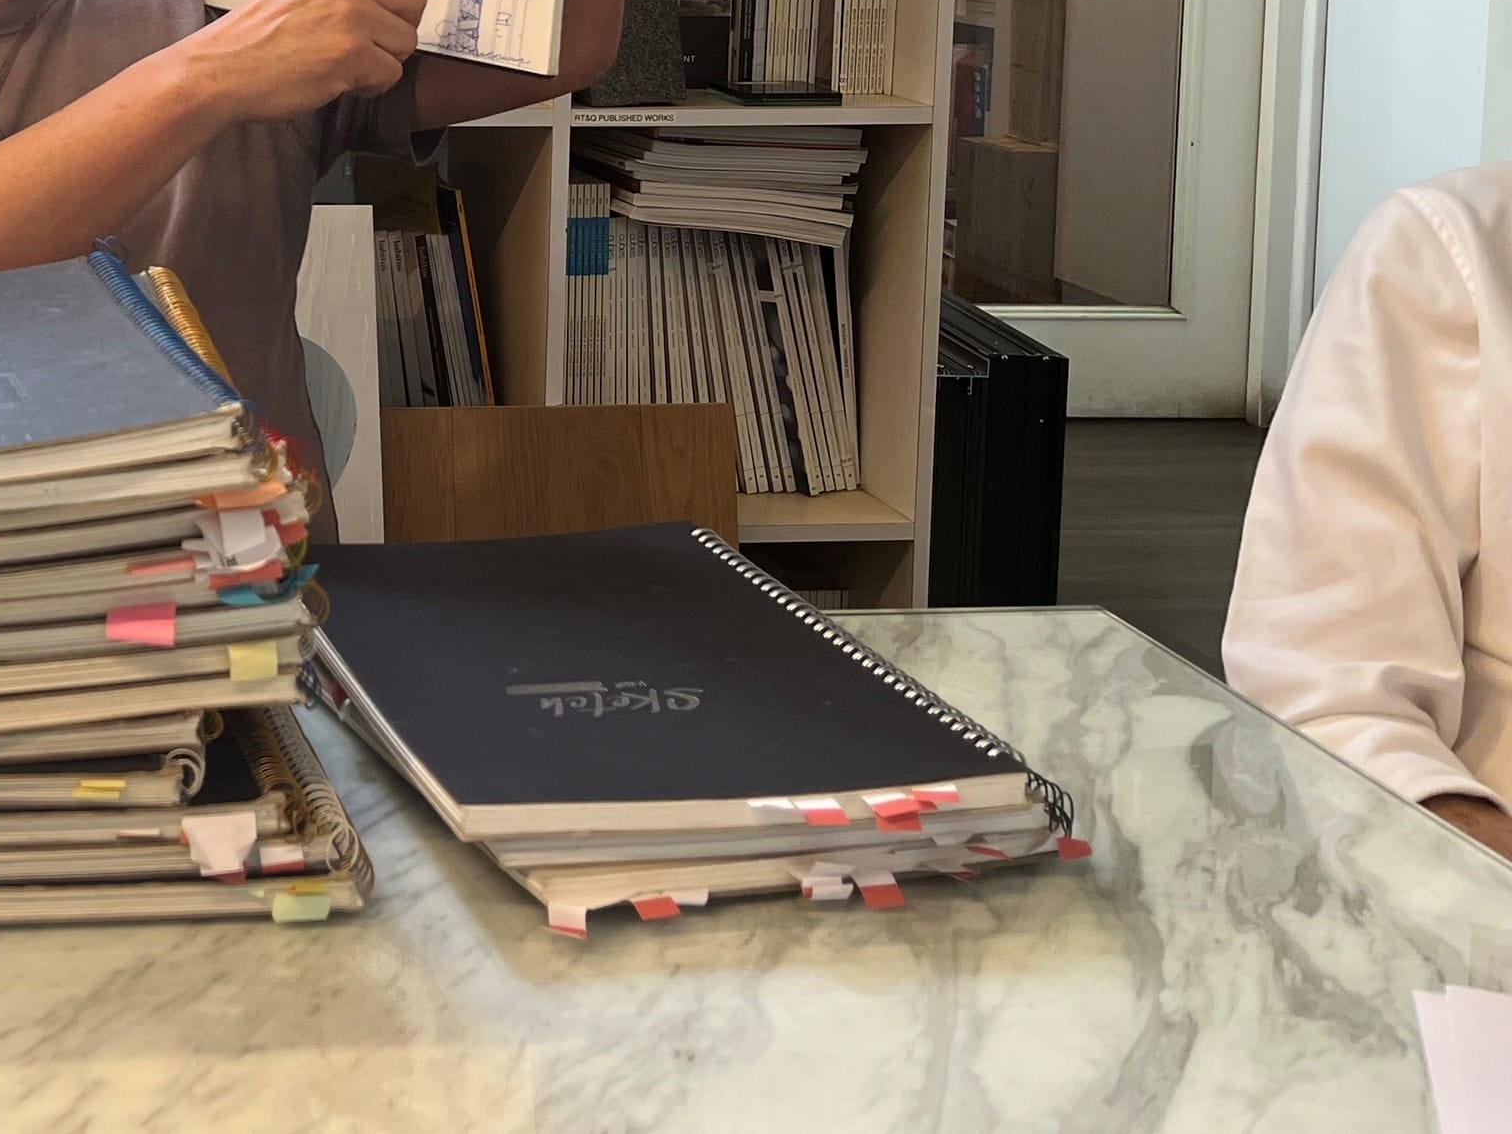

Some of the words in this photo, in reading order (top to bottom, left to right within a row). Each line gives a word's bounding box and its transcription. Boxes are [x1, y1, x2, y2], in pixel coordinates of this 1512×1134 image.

[574, 113, 597, 123] RT&Q
[598, 113, 643, 122] PUBLISHED
[644, 113, 675, 122] WORKS
